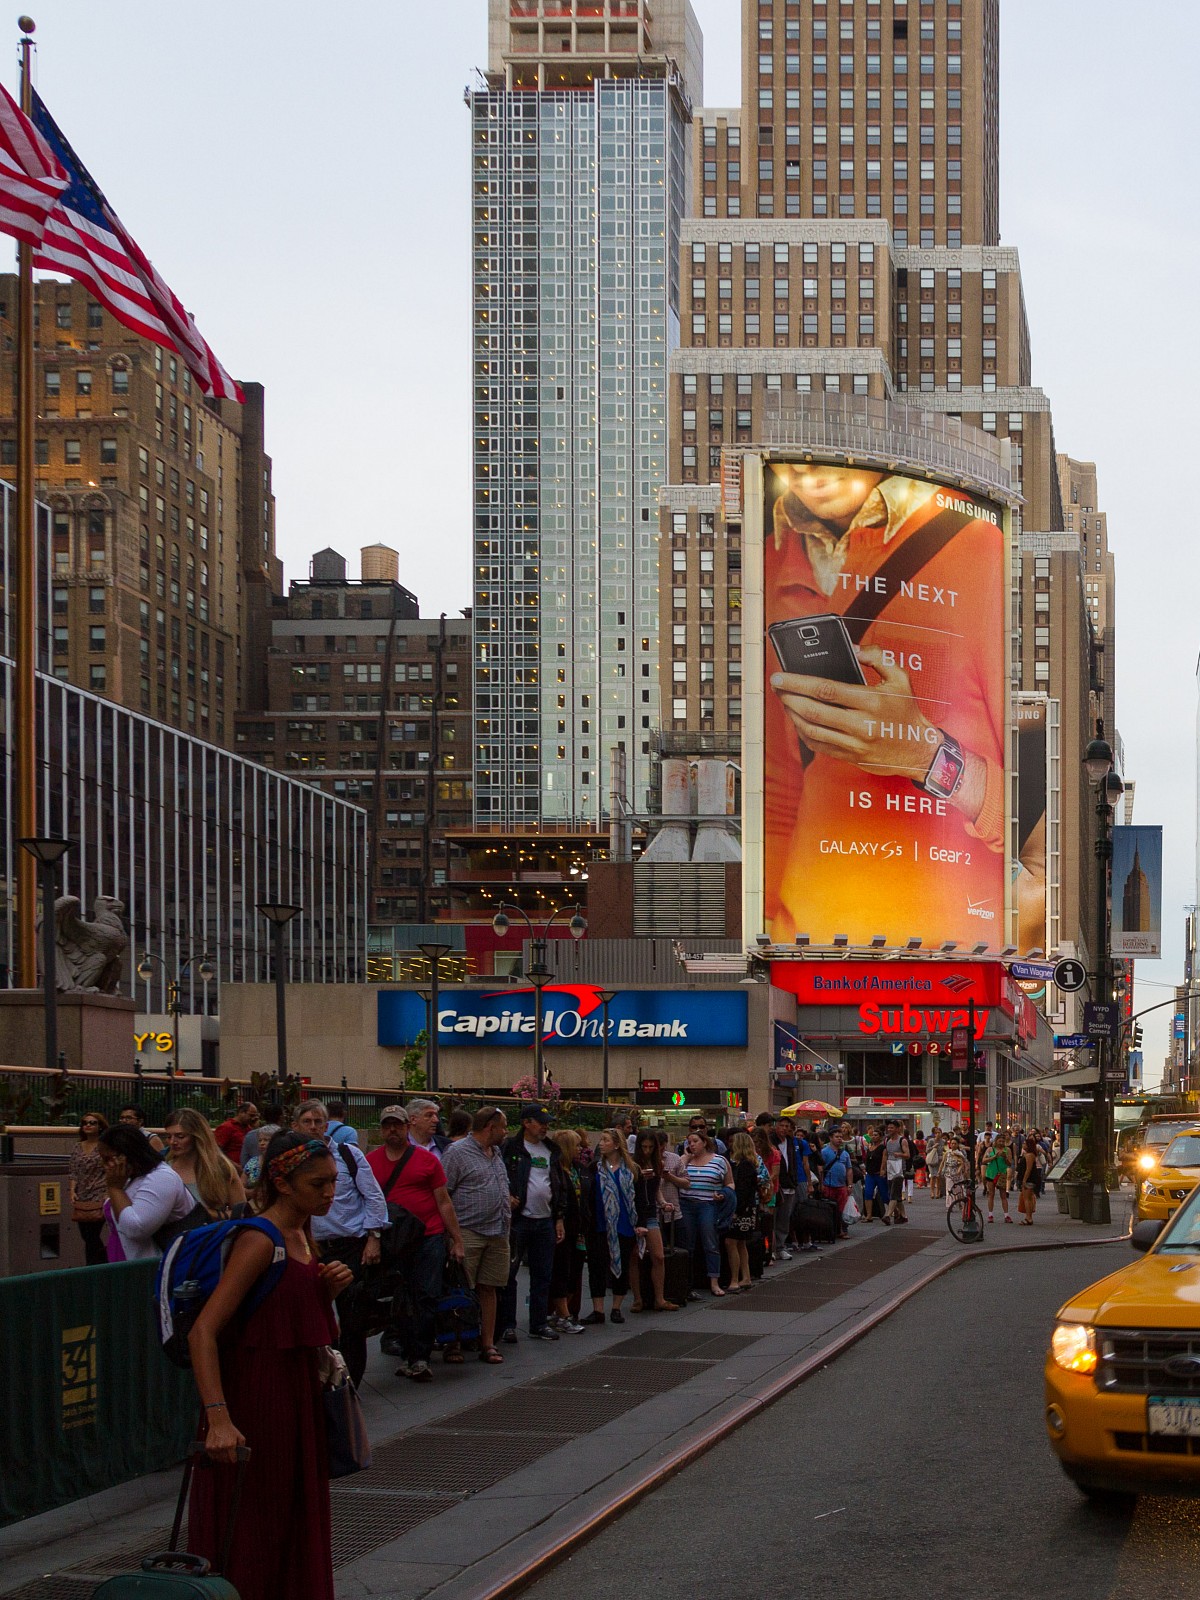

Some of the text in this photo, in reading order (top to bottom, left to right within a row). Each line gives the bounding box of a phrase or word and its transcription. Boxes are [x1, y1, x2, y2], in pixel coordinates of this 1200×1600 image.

[936, 493, 997, 525] SAMSUNG
[838, 573, 958, 607] THE NEXT
[803, 650, 829, 659] SAMSUNG
[882, 649, 922, 671] BIG
[864, 720, 938, 744] THING
[850, 791, 947, 816] IS HERE
[820, 840, 879, 856] GALAXY
[929, 846, 971, 865] Gear 2
[967, 907, 995, 919] verizon
[1016, 965, 1053, 978] Van Wagner
[814, 975, 932, 990] Bank of America
[437, 1010, 688, 1038] Capital One Bank
[858, 1002, 990, 1040] Subway
[1088, 1022, 1111, 1031] Security
[1061, 1038, 1080, 1047] West
